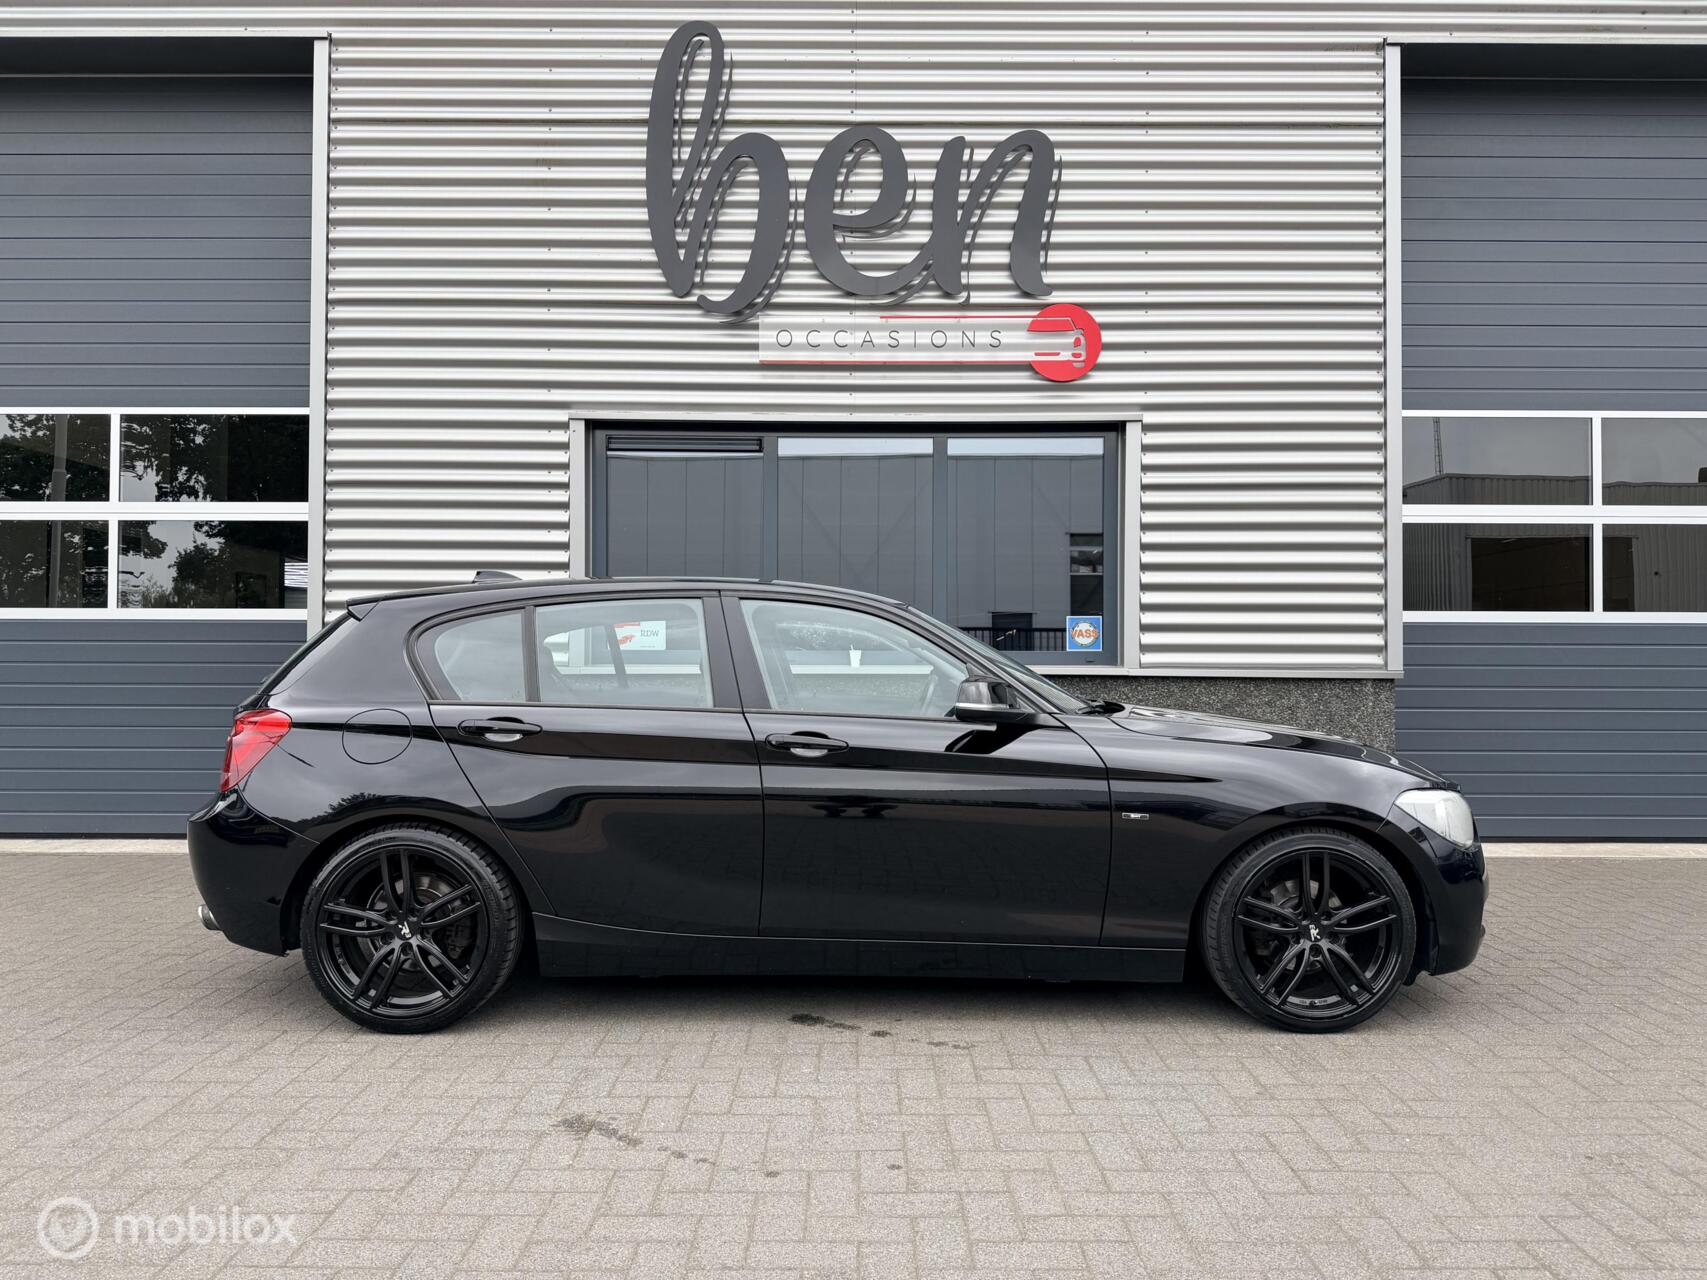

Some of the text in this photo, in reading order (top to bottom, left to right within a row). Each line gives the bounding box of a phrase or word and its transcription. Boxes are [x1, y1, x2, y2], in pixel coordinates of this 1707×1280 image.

[645, 20, 1054, 314] ben
[776, 329, 1001, 348] OCCASIONS
[640, 629, 659, 637] RDW
